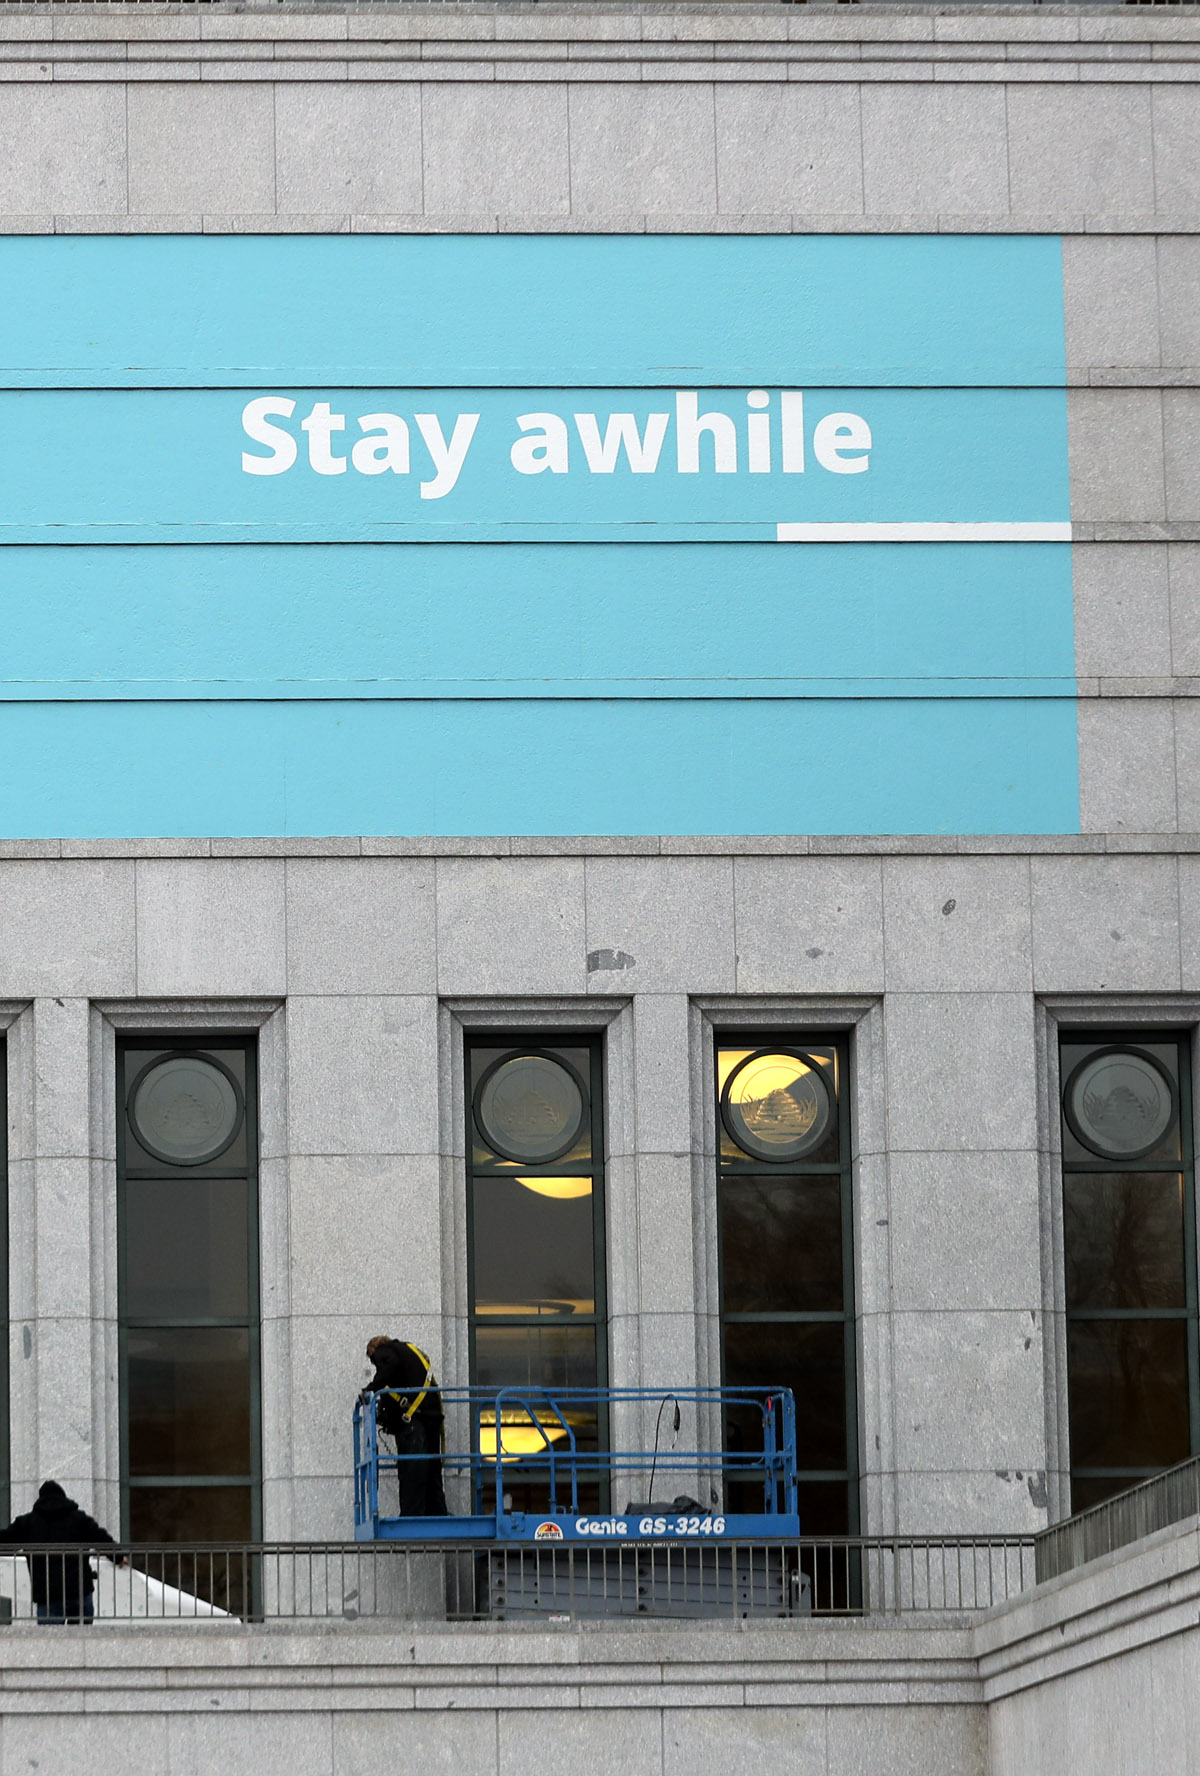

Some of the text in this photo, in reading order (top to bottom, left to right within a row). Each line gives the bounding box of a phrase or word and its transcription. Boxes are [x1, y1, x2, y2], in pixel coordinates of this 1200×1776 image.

[241, 391, 873, 499] Stay awhile
[575, 1516, 726, 1535] Genie GS-3246
